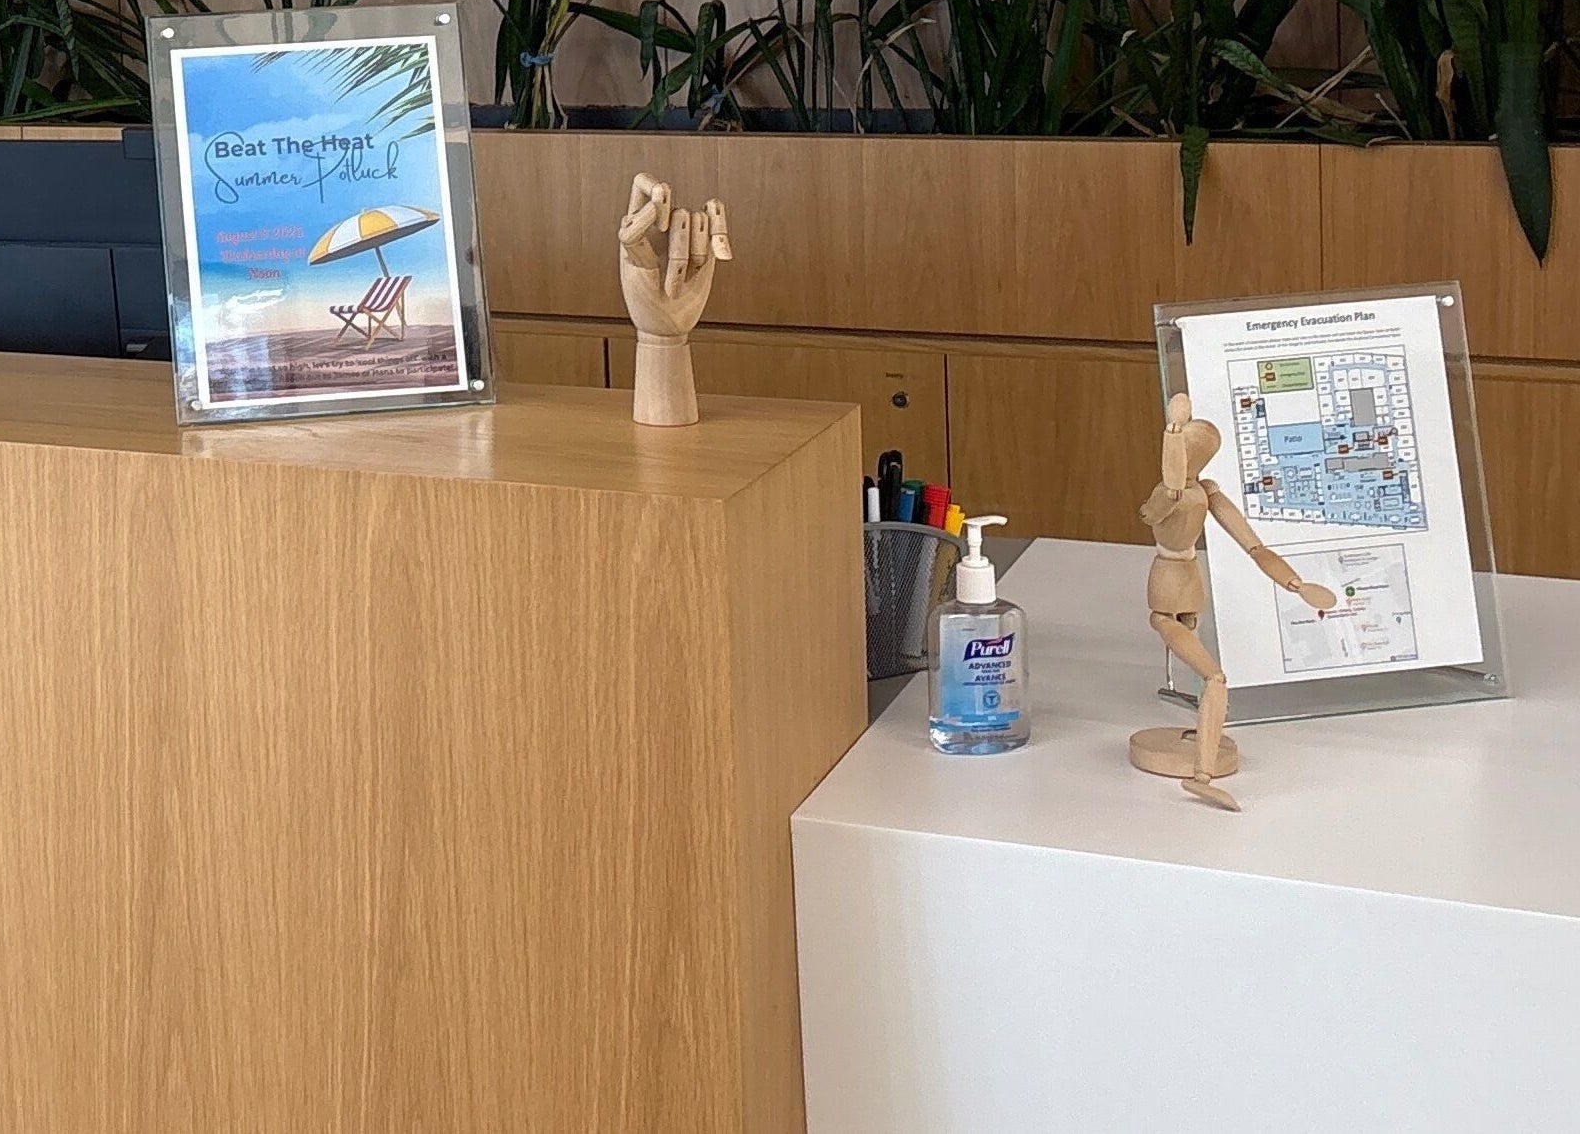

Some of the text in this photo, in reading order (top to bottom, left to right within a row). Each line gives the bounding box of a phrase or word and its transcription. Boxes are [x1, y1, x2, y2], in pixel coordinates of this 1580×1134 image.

[215, 133, 374, 158] Beat The Heat
[204, 131, 399, 204] Summer Potluck
[248, 268, 280, 279] Noon
[1246, 311, 1376, 332] Emergency Evacuation Plan
